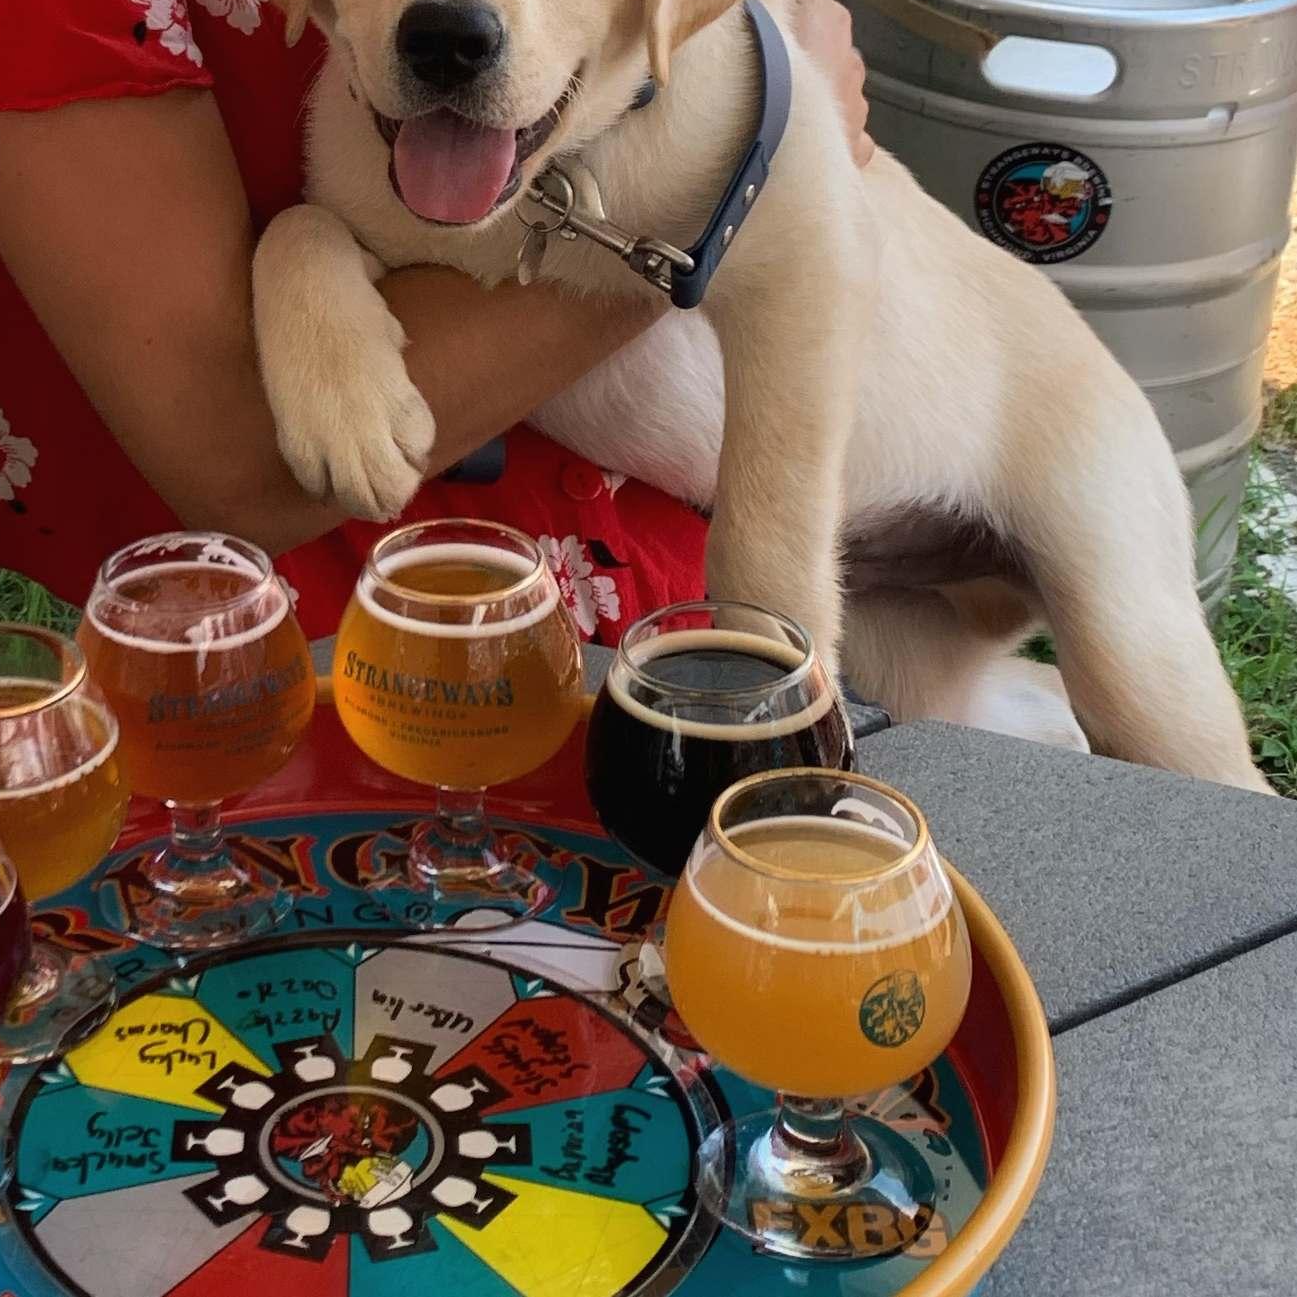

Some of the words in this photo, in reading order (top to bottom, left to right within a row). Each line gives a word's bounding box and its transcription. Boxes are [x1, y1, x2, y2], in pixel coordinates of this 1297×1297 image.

[343, 649, 514, 708] STRANGEWAYS
[138, 1040, 218, 1076] Lucky
[86, 1110, 163, 1148] Jelly
